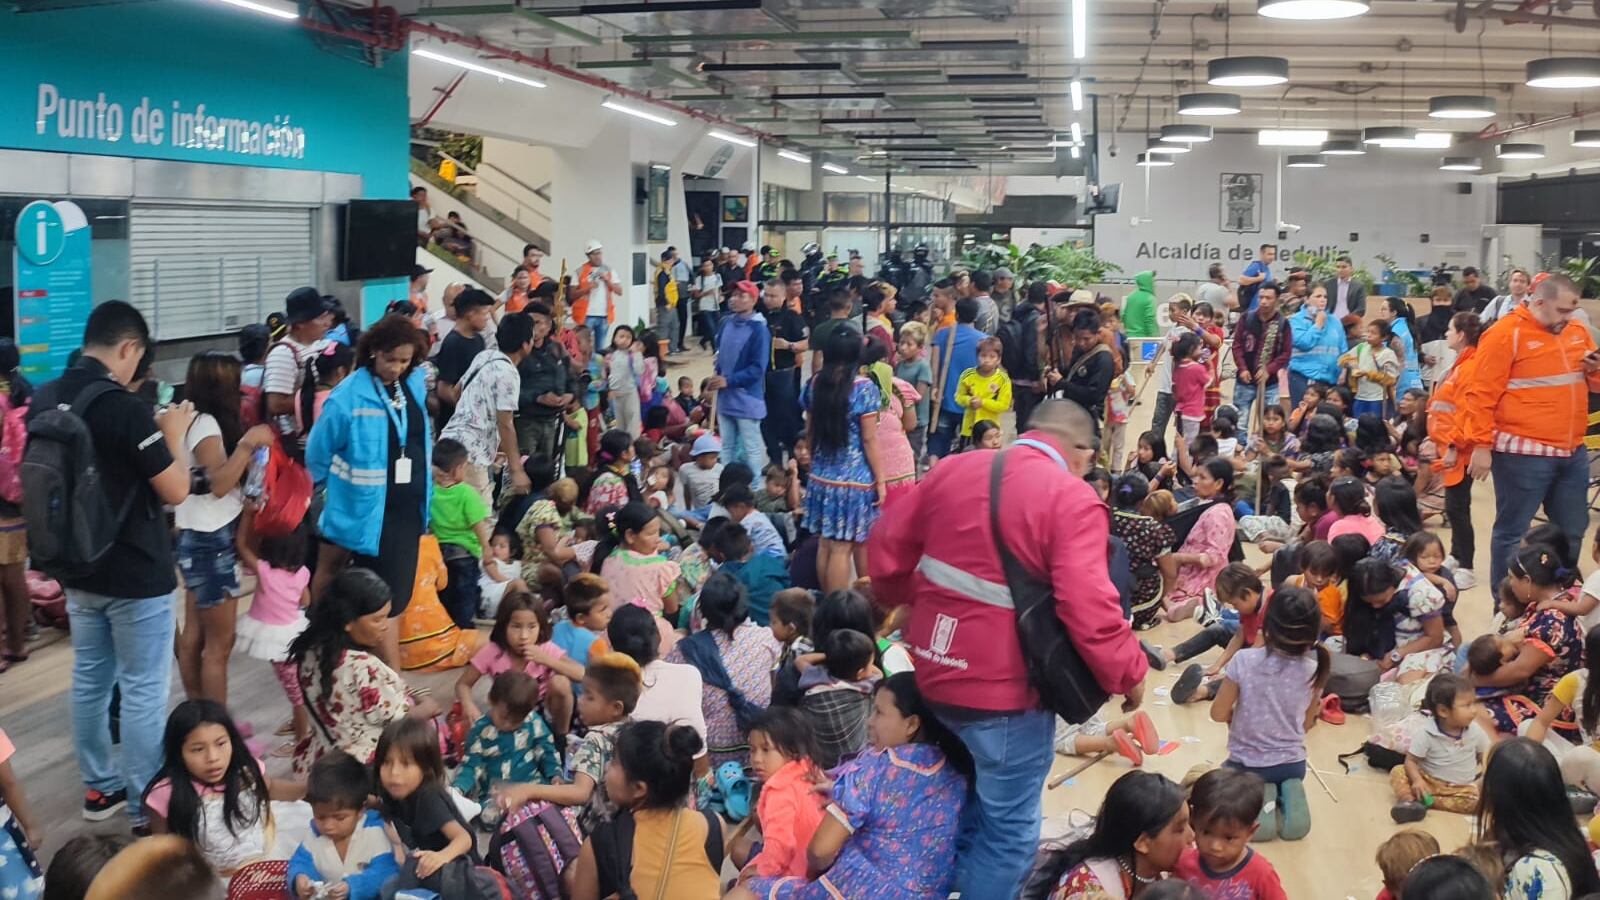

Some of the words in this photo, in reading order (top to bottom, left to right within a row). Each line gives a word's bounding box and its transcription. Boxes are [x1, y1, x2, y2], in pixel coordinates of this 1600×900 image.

[36, 83, 123, 142] Punto
[132, 97, 164, 146] de
[171, 101, 305, 159] información
[1136, 242, 1221, 260] Alcaldía
[1228, 244, 1253, 260] de
